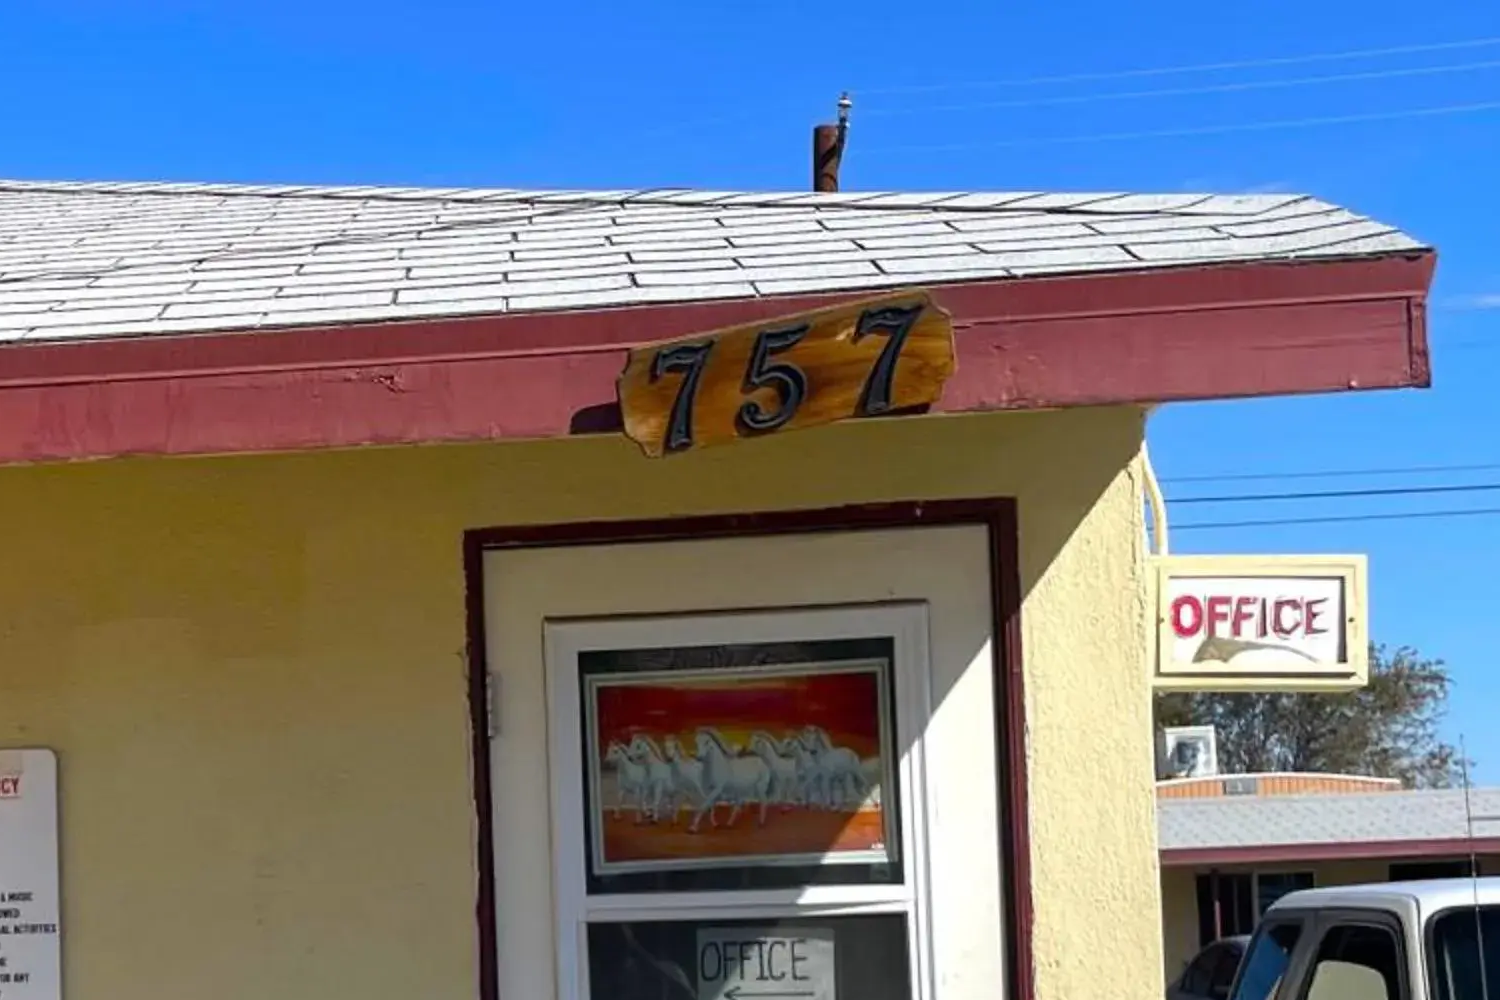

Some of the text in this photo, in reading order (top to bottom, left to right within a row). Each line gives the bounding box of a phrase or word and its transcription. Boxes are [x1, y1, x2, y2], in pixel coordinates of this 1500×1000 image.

[648, 302, 925, 453] 757
[1171, 594, 1329, 638] OFFICE
[701, 938, 812, 982] OFFICE
